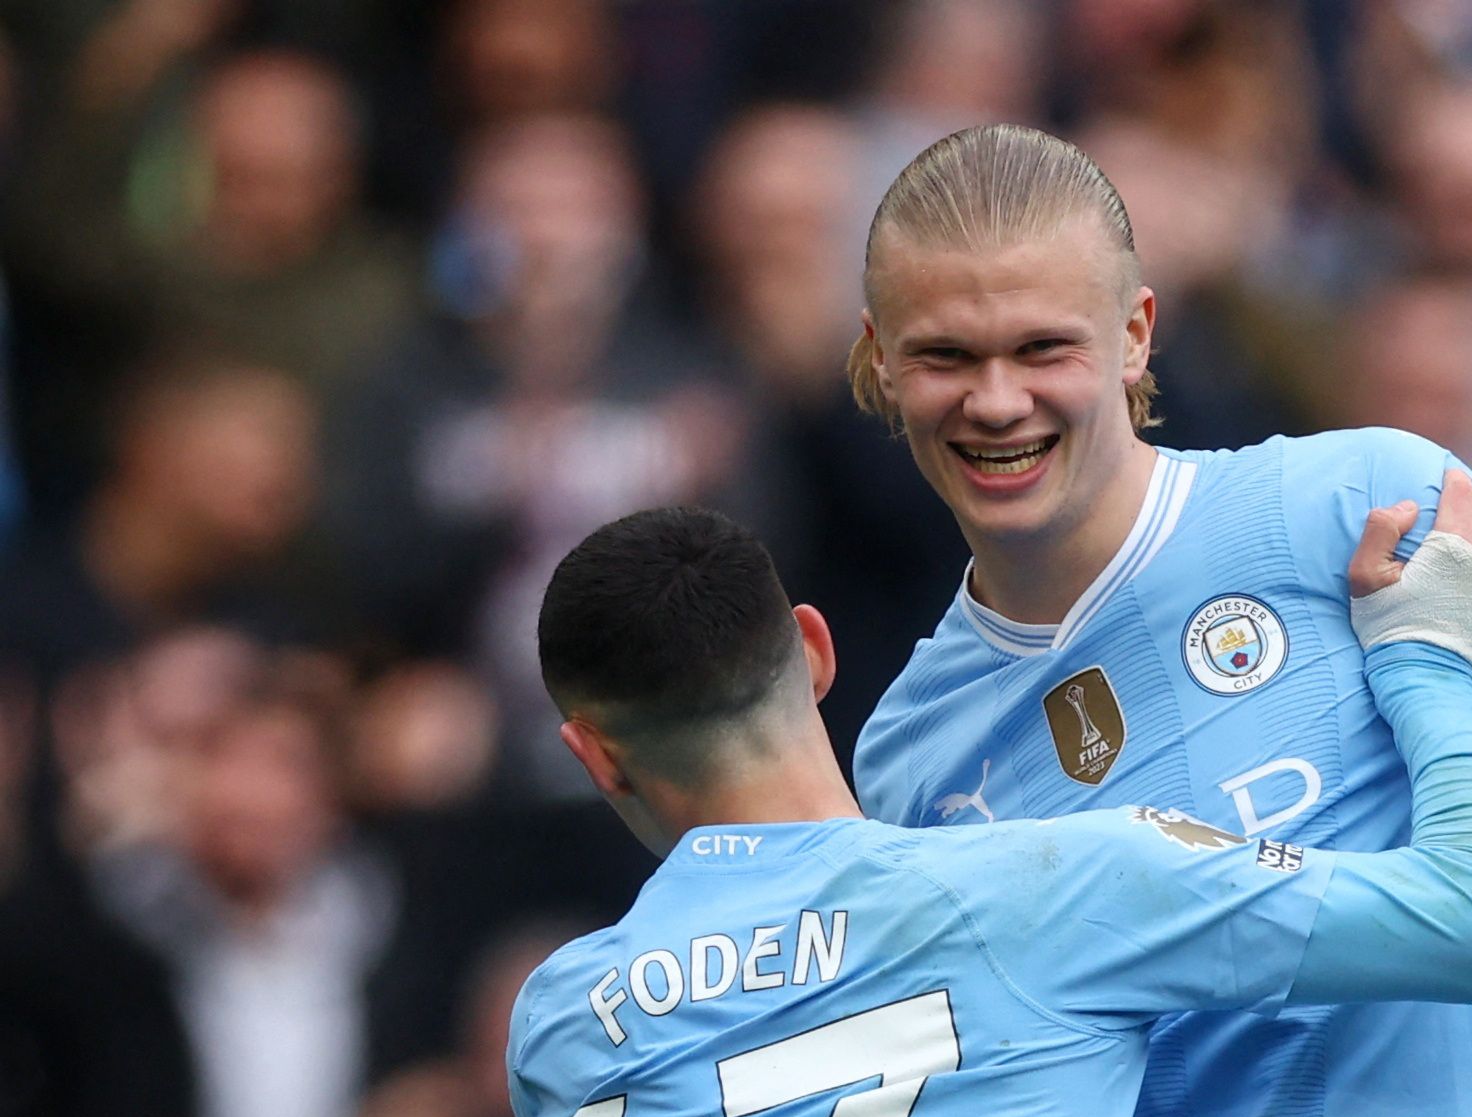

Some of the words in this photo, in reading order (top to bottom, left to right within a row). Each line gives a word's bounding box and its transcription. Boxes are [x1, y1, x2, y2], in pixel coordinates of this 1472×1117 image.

[1190, 601, 1267, 648] MANCHESTER
[1233, 672, 1263, 690] CITY
[1079, 741, 1110, 765] FIFA
[692, 835, 763, 856] CITY
[588, 909, 848, 1048] FODEN
